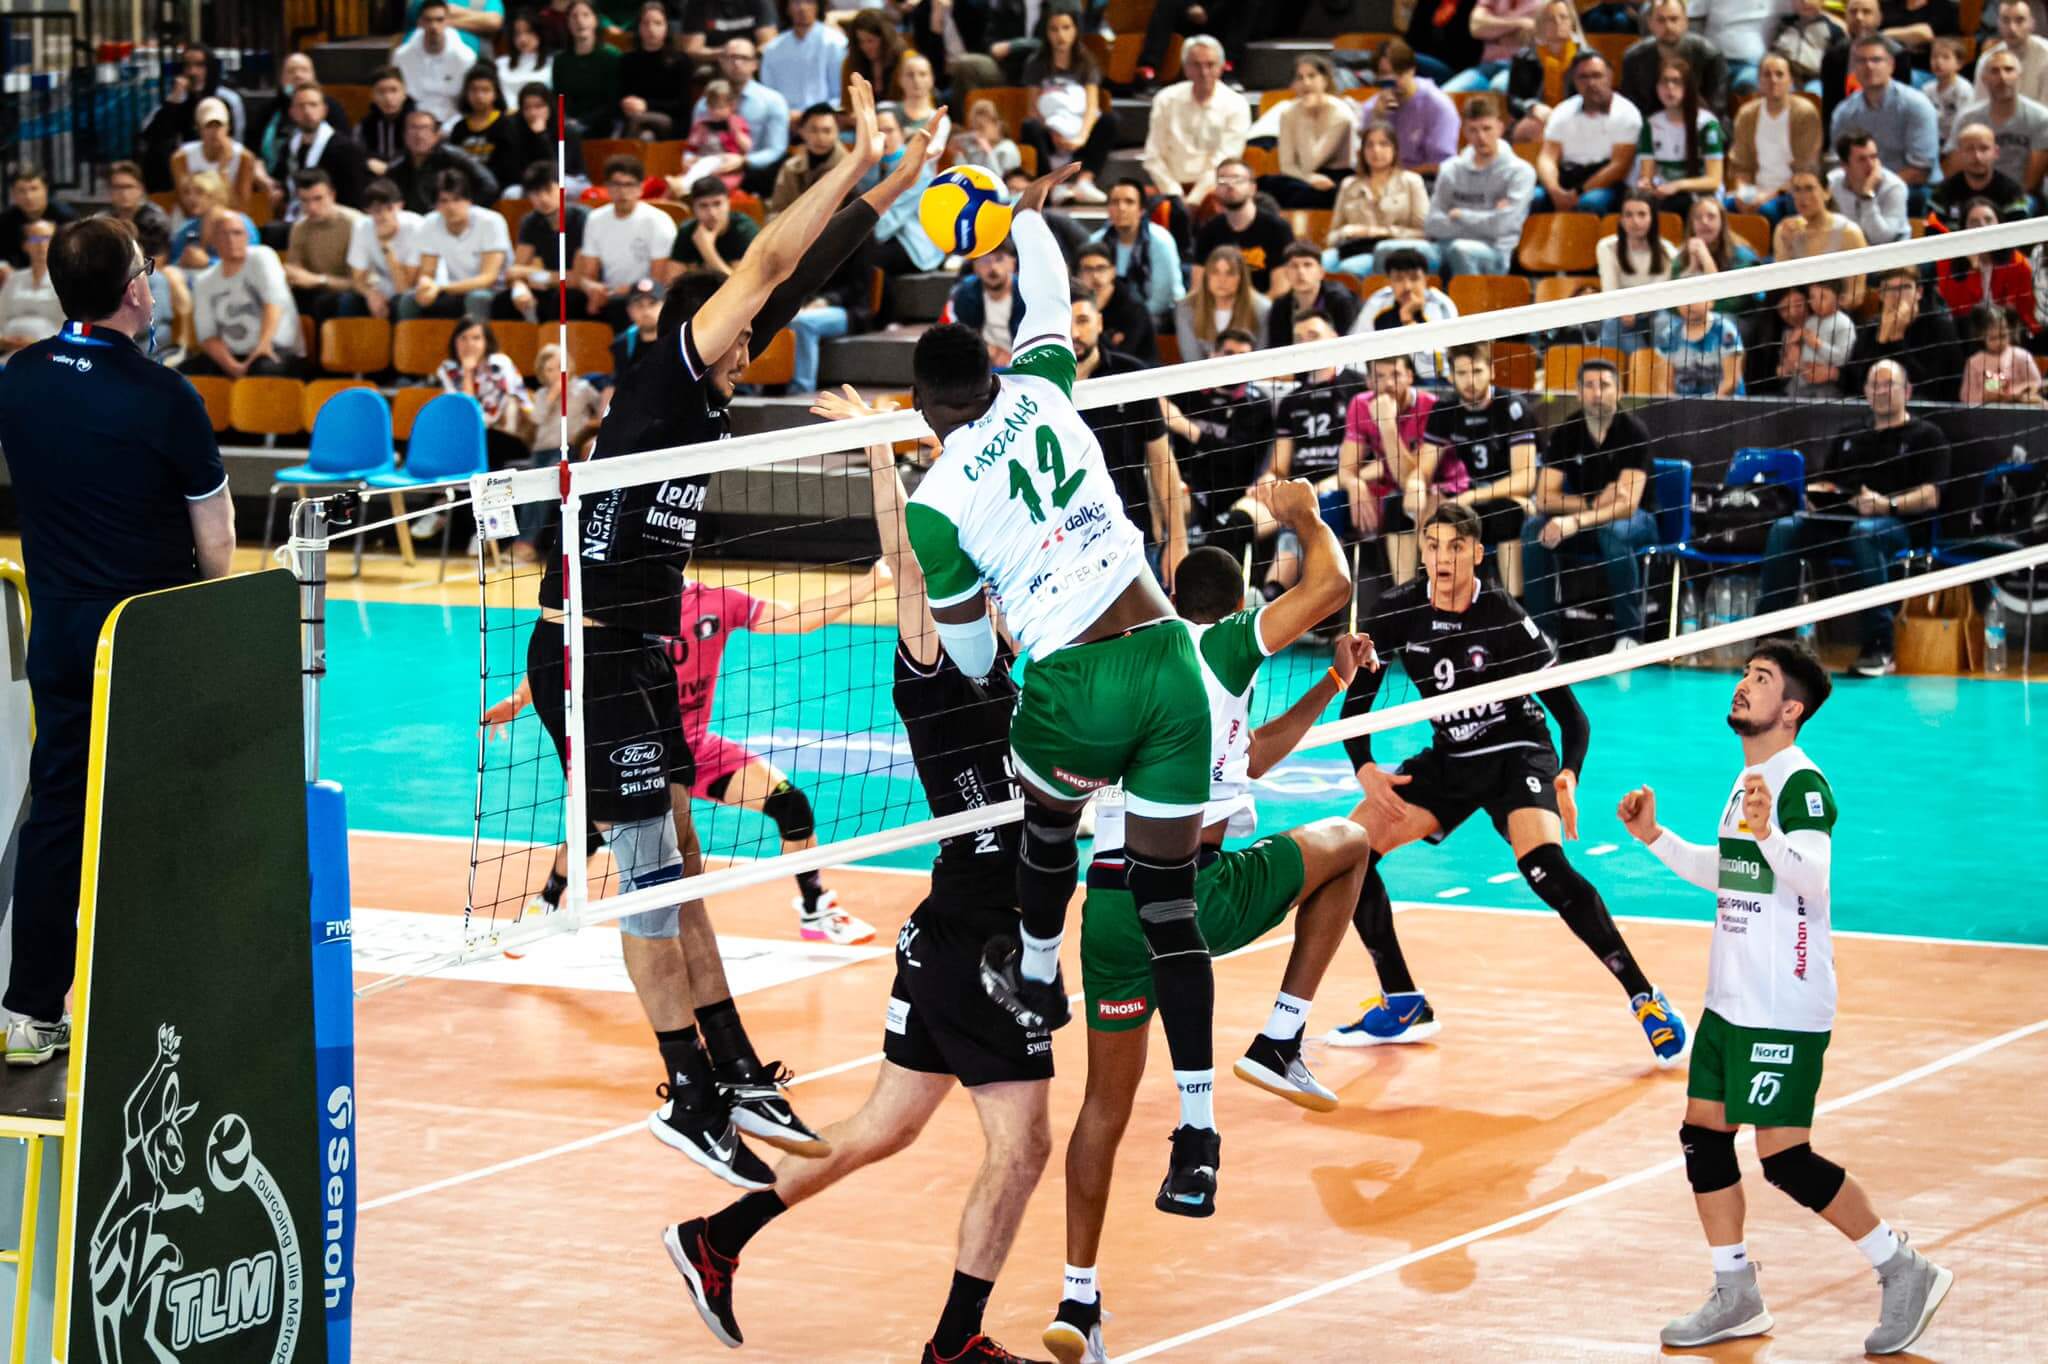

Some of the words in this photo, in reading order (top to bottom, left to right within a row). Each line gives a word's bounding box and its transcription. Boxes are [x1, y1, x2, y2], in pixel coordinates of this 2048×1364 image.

[1303, 413, 1331, 438] 12
[1008, 425, 1087, 525] 12
[1474, 446, 1489, 470] 3
[1433, 657, 1455, 691] 9
[621, 745, 656, 763] Ford
[1526, 776, 1542, 793] 9
[1793, 920, 1808, 980] Auchan
[1100, 1001, 1144, 1015] PENOSIL
[1754, 1045, 1790, 1059] Nord
[1747, 1071, 1785, 1106] 15
[252, 1168, 293, 1249] Tourcoing
[285, 1251, 300, 1291] Lille
[325, 1136, 351, 1309] Senoh
[166, 1251, 277, 1351] TLM
